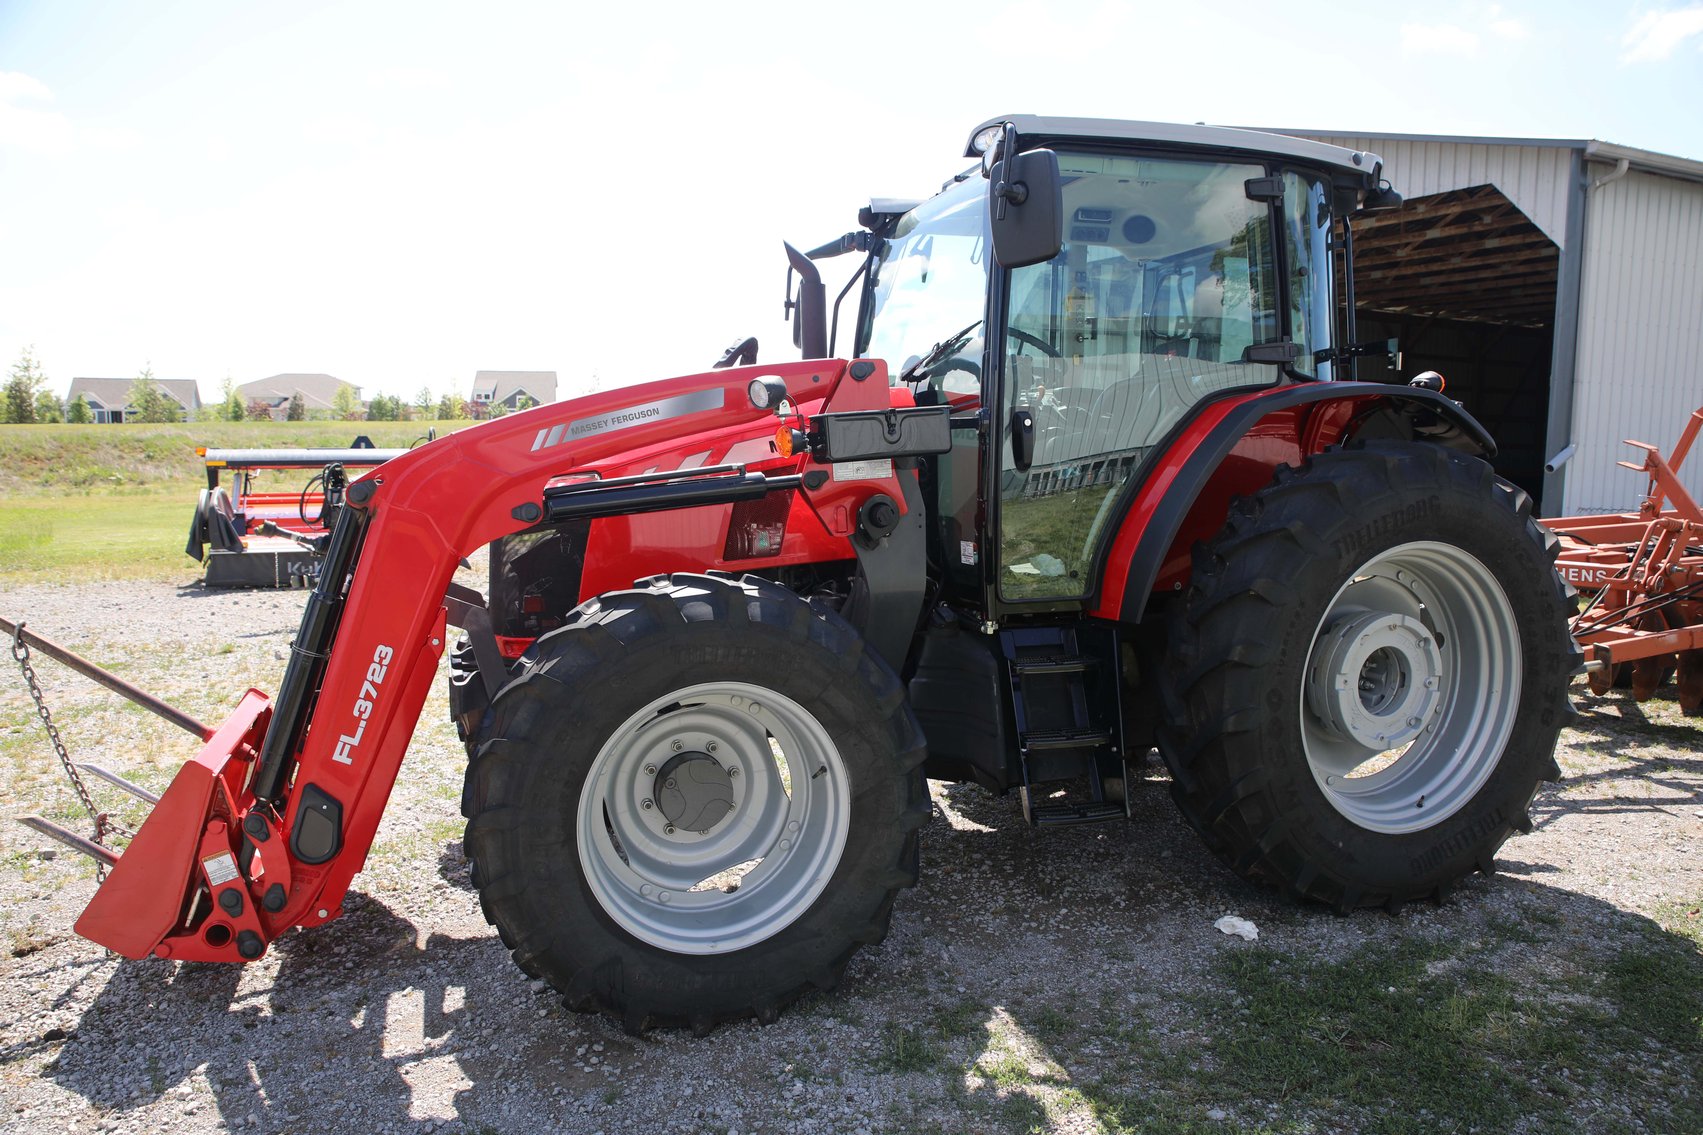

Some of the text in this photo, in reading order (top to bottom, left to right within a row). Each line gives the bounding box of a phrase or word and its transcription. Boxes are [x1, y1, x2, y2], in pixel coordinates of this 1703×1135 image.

[571, 407, 660, 435] MASSEY FERGUSON
[332, 644, 394, 765] FL.3723
